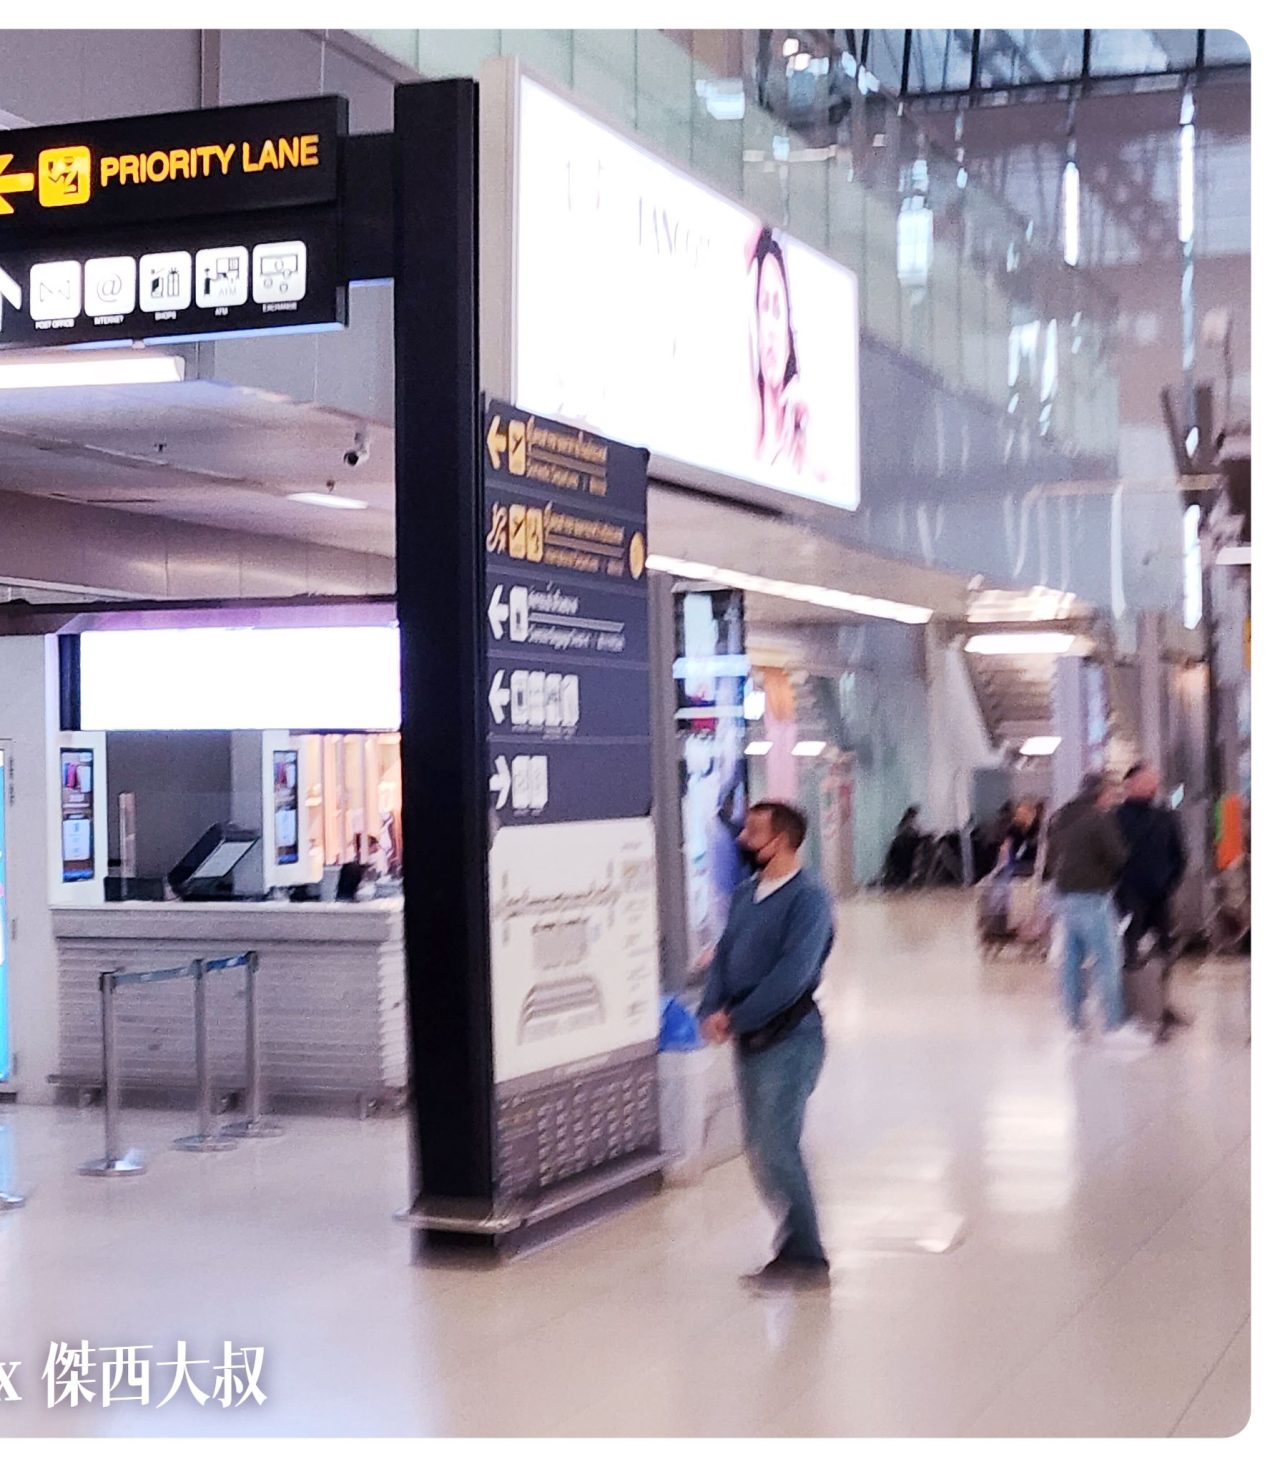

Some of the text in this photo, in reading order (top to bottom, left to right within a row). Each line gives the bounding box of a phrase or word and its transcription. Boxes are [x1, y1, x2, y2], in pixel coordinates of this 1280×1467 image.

[100, 134, 319, 187] PRIORITY LANE
[215, 306, 229, 316] ATM
